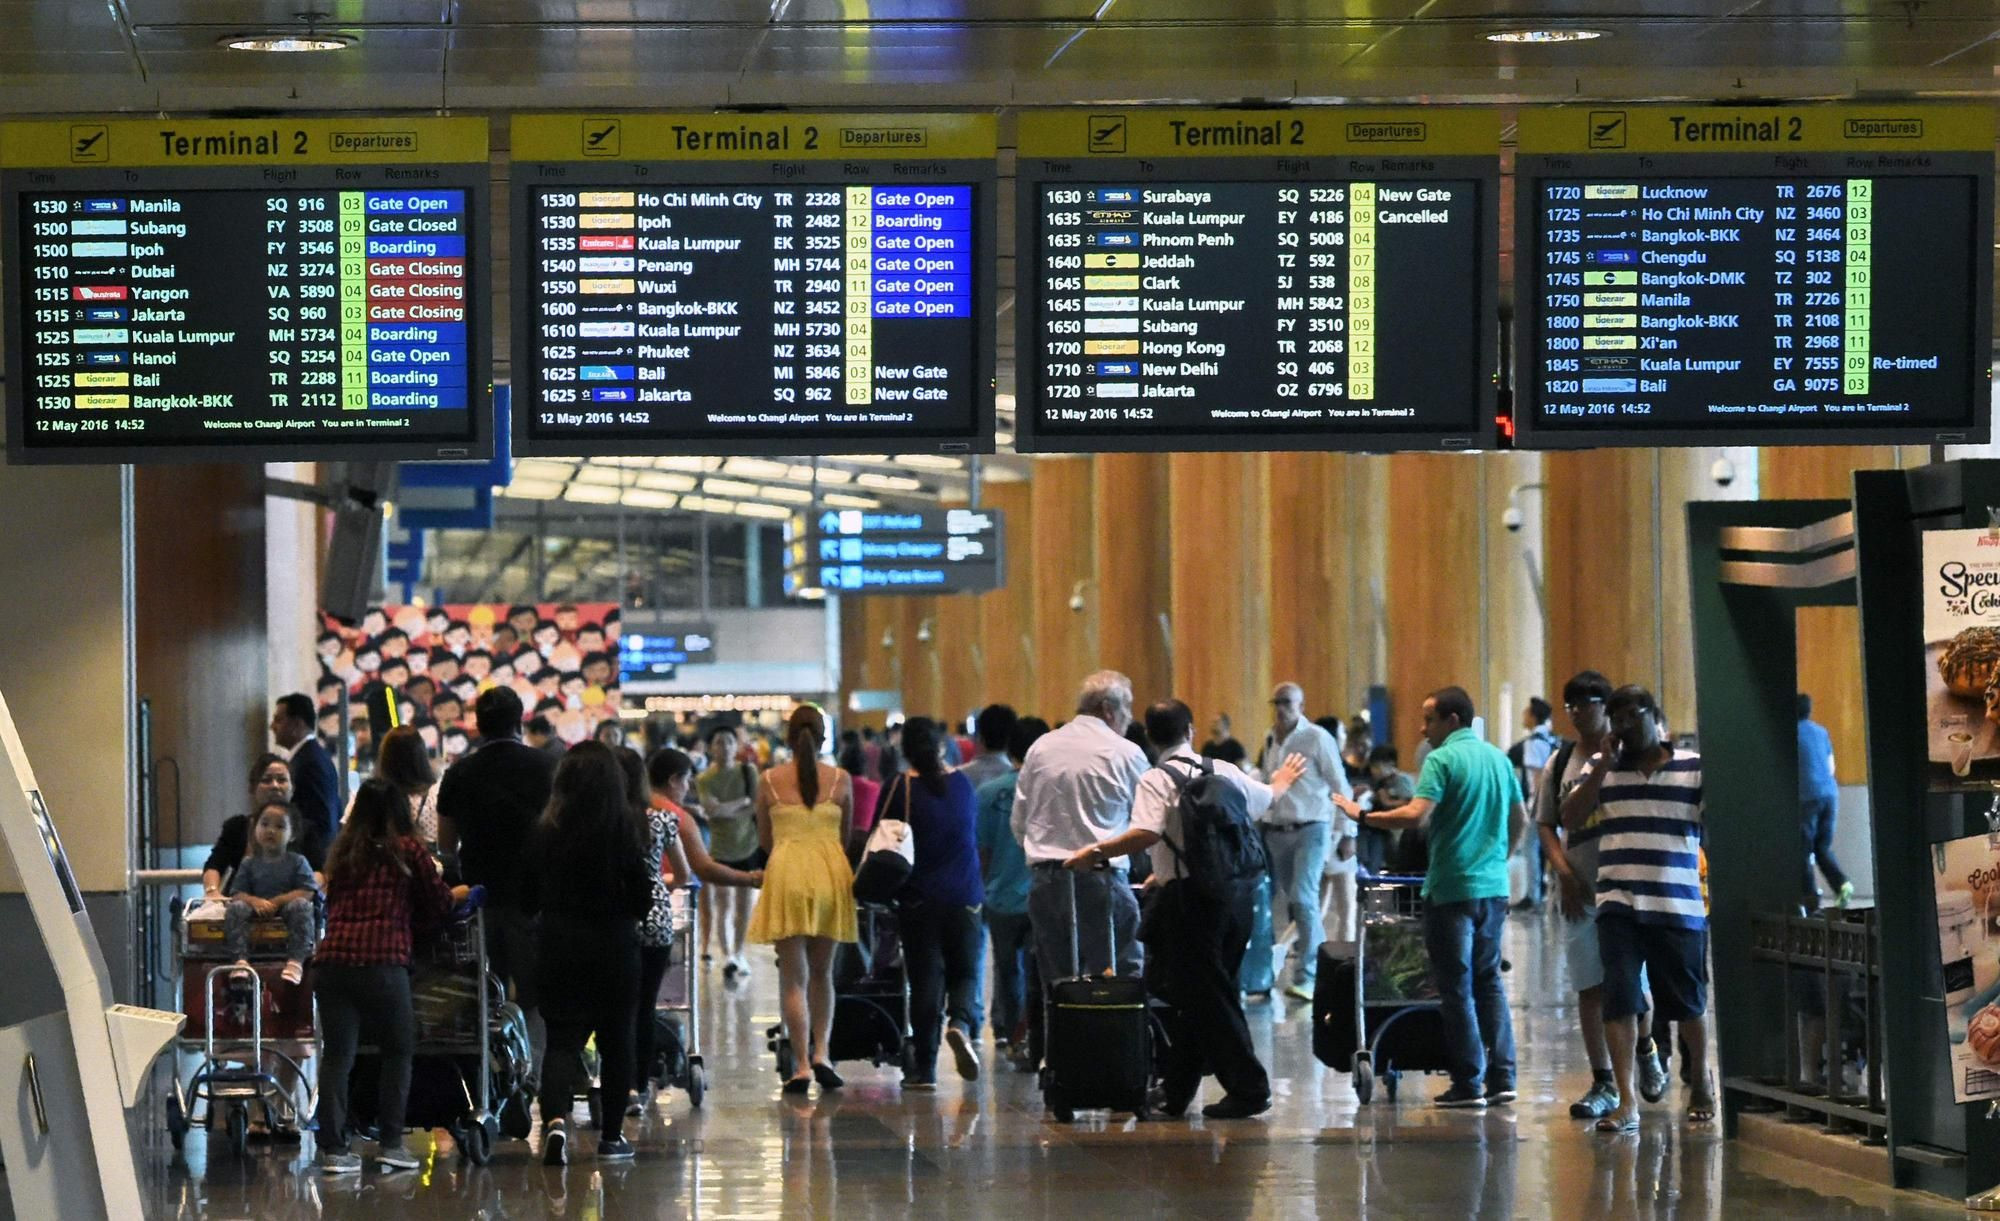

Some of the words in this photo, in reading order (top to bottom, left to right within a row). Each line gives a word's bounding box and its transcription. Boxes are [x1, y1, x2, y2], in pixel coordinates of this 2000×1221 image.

[1170, 122, 1280, 145] Terminal
[1290, 122, 1304, 144] 2
[1352, 125, 1420, 139] Departures
[1670, 118, 1780, 142] Terminal
[1788, 118, 1802, 140] 2
[1850, 122, 1917, 135] Departures
[160, 132, 278, 155] Terminal
[293, 132, 308, 154] 2
[335, 134, 411, 149] Departures
[672, 127, 788, 150] Terminal
[804, 127, 819, 149] 2
[844, 130, 921, 145] Departures
[27, 173, 56, 183] Time
[124, 171, 138, 181] To
[264, 169, 296, 181] Flight
[336, 169, 361, 179] Row
[385, 168, 439, 180] Remarks
[33, 201, 67, 214] 1530
[130, 199, 181, 212] Manila
[267, 198, 287, 213] SQ
[298, 198, 325, 211] 916
[343, 197, 360, 210] 03
[369, 198, 403, 210] Gate
[408, 197, 448, 213] Open
[541, 194, 576, 207] 1530
[638, 193, 659, 207] Ho
[663, 193, 687, 206] Chi
[691, 193, 729, 206] Minh
[733, 193, 762, 209] City
[774, 193, 792, 206] TR
[805, 193, 840, 206] 2328
[853, 193, 867, 205] 12
[875, 193, 911, 205] Gate
[915, 192, 954, 208] Open
[1047, 191, 1081, 203] 1630
[1143, 189, 1211, 206] Surabaya
[1278, 189, 1299, 204] SQ
[1310, 189, 1344, 202] 5226
[1354, 189, 1371, 201] 04
[1379, 189, 1413, 202] New
[1416, 189, 1451, 201] Gate
[1047, 212, 1081, 225] 1635
[1143, 211, 1184, 225] Kuala
[1189, 212, 1245, 227] Lumpur
[1278, 211, 1297, 224] EY
[1309, 211, 1344, 224] 4186
[1354, 211, 1371, 223] 09
[1379, 209, 1448, 223] Cancelled
[1547, 208, 1580, 221] 1725
[1642, 208, 1663, 220] Ho
[1667, 207, 1690, 220] Chi
[1694, 207, 1731, 220] Minh
[1736, 207, 1764, 223] City
[1776, 207, 1796, 219] NZ
[1807, 207, 1841, 220] 3460
[1850, 206, 1867, 219] 03
[33, 223, 68, 236] 1500
[130, 221, 186, 237] Subang
[267, 220, 286, 233] FY
[299, 220, 334, 233] 3508
[343, 219, 361, 232] 09
[369, 219, 404, 232] Gate
[408, 218, 457, 231] Closed
[541, 237, 575, 251] 1535
[638, 236, 680, 250] Kuala
[684, 237, 741, 253] Lumpur
[774, 236, 793, 249] EK
[805, 236, 840, 249] 3525
[850, 236, 867, 249] 09
[876, 236, 910, 249] Gate
[914, 236, 954, 252] Open
[1048, 234, 1081, 247] 1635
[1143, 233, 1194, 246] Phnom
[1198, 233, 1234, 246] Penh
[1278, 232, 1299, 247] SQ
[1310, 232, 1344, 245] 5008
[1354, 232, 1370, 244] 04
[34, 266, 68, 279] 1510
[131, 264, 175, 278] Dubai
[268, 264, 288, 276] NZ
[300, 263, 335, 276] 3274
[344, 263, 361, 276] 03
[370, 263, 405, 275] Gate
[409, 262, 462, 278] Closing
[1546, 273, 1580, 286] 1745
[1642, 271, 1745, 288] Bangkok-DMK
[1775, 272, 1792, 284] TZ
[1806, 271, 1831, 284] 302
[1851, 271, 1867, 283] 10
[542, 302, 576, 316] 1600
[638, 301, 738, 318] Bangkok-BKK
[774, 301, 794, 314] NZ
[805, 301, 840, 314] 3452
[850, 301, 867, 314] 03
[875, 301, 910, 314] Gate
[914, 301, 954, 316] Open
[36, 331, 70, 344] 1525
[133, 330, 174, 343] Kuala
[178, 330, 235, 346] Lumpur
[269, 329, 295, 342] MH
[301, 329, 335, 341] 5734
[345, 328, 362, 341] 04
[371, 327, 437, 343] Boarding
[1546, 337, 1579, 350] 1800
[1640, 336, 1677, 349] Xi'an
[1774, 336, 1792, 348] TR
[1805, 335, 1839, 348] 2968
[1850, 336, 1864, 347] 11
[542, 367, 576, 381] 1625
[638, 366, 665, 380] Bali
[774, 366, 793, 379] MI
[806, 366, 840, 379] 5846
[850, 366, 866, 378] 03
[875, 366, 909, 379] New
[913, 365, 948, 378] Gate
[1047, 363, 1081, 376] 1710
[1143, 363, 1176, 376] New
[1180, 362, 1218, 375] Delhi
[1277, 362, 1298, 377] SQ
[1308, 362, 1334, 375] 406
[1353, 361, 1369, 374] 03
[1546, 359, 1579, 371] 1845
[1641, 358, 1681, 371] Kuala
[1685, 358, 1741, 373] Lumpur
[1774, 357, 1793, 370] EY
[1805, 357, 1839, 370] 7555
[1848, 357, 1865, 369] 09
[1873, 356, 1937, 369] Re-timed
[36, 421, 49, 431] 12
[52, 420, 78, 433] May
[81, 420, 108, 430] 2016
[115, 419, 144, 430] 14:52
[203, 420, 242, 428] Welcome
[255, 420, 283, 429] Changi
[285, 419, 315, 429] Airport
[366, 418, 402, 426] Terminal
